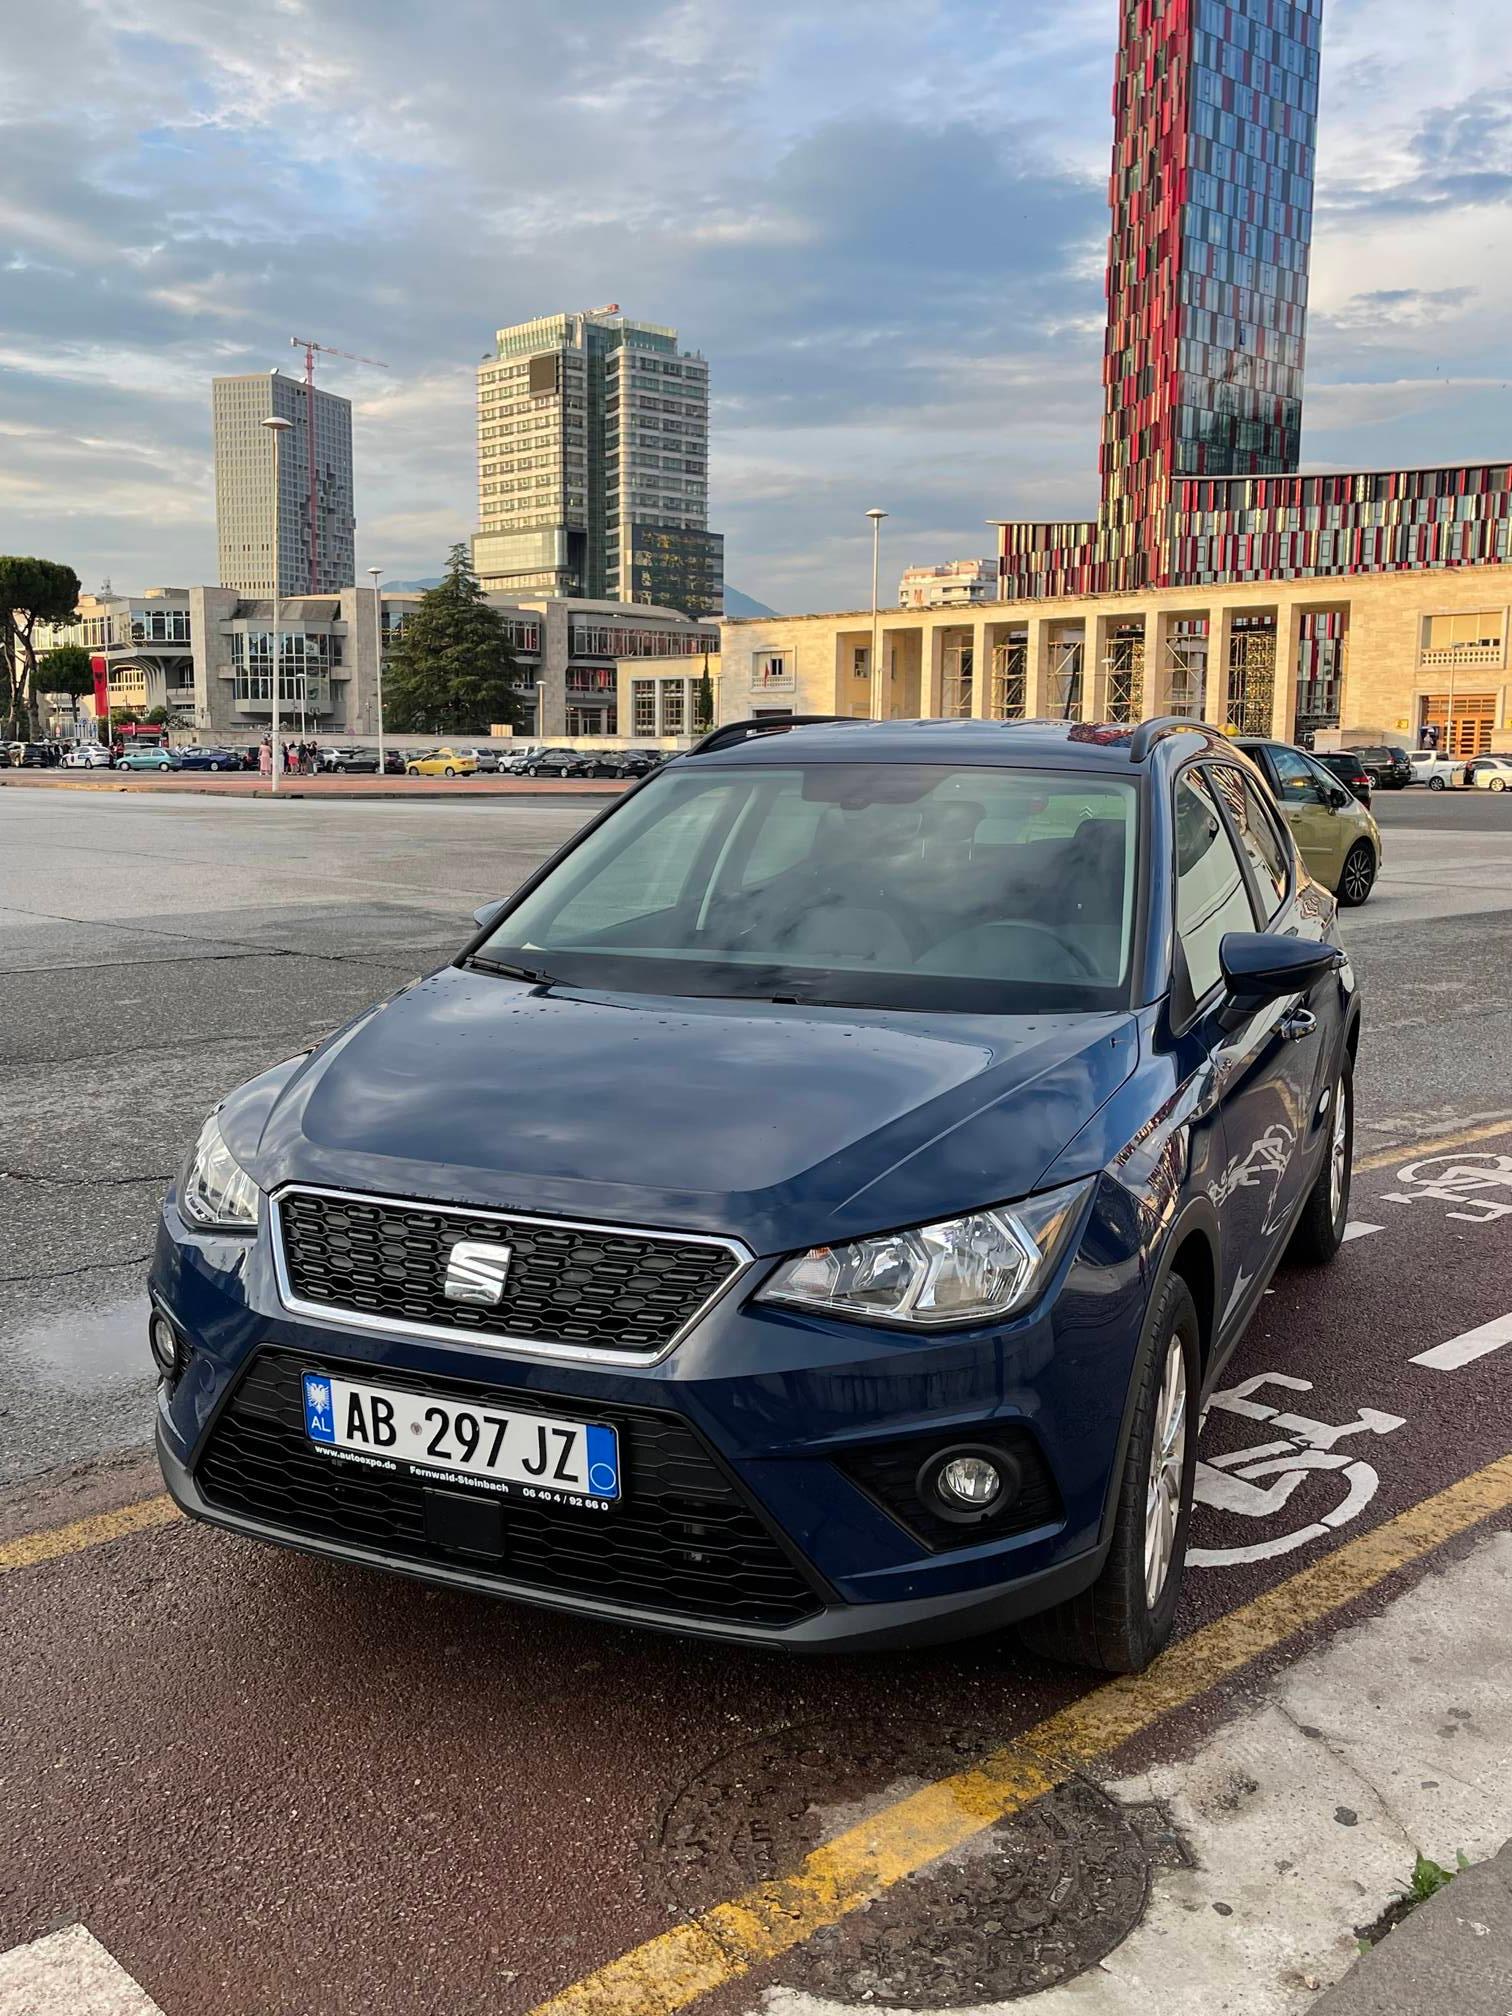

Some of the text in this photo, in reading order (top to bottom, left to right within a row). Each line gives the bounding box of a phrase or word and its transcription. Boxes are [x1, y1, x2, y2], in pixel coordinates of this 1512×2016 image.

[311, 1415, 331, 1433] AL
[346, 1391, 579, 1483] AB 297 JZ
[314, 1445, 397, 1470] www.autoexpo.de
[409, 1465, 509, 1493] Fernwald-Steinbach
[522, 1487, 536, 1498] 06
[538, 1490, 552, 1501] 40
[568, 1496, 583, 1507] 92
[584, 1499, 599, 1510] 66
[600, 1501, 609, 1511] 0
